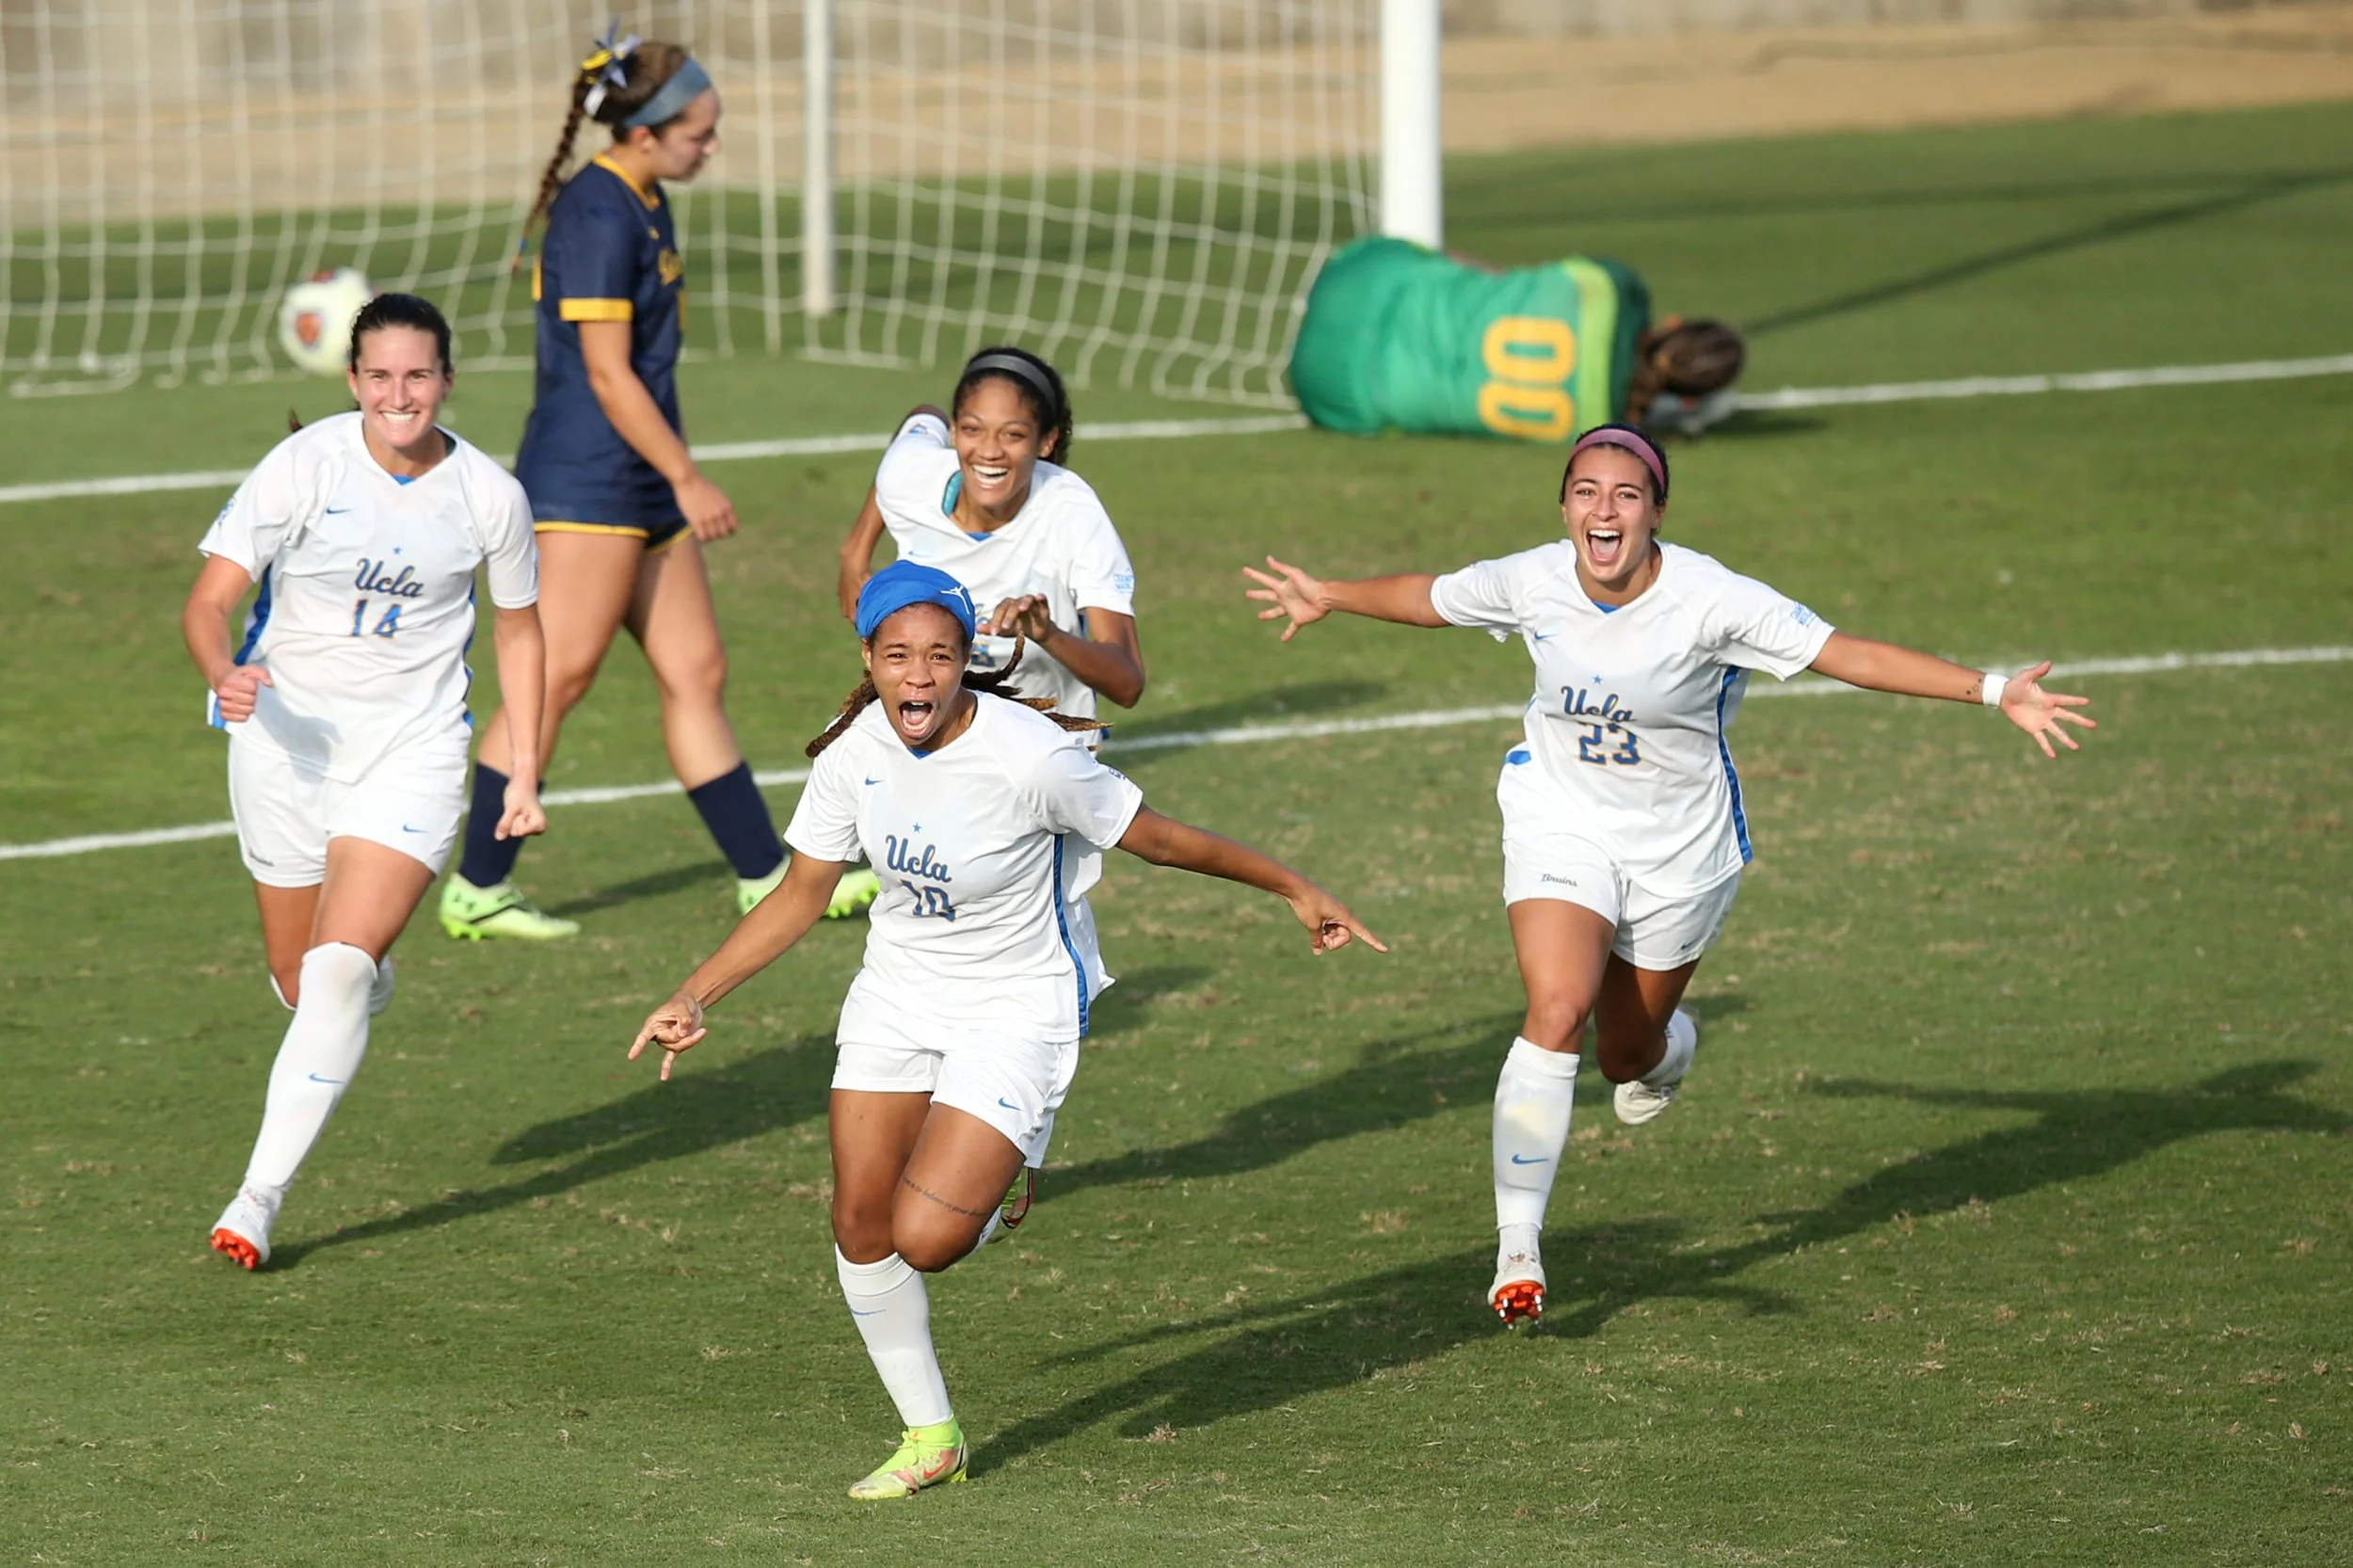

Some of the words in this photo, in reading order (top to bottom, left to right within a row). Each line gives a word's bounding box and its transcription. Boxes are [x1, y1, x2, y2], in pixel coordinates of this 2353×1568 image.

[1478, 316, 1576, 441] 00
[355, 558, 424, 598] Ucla
[1578, 722, 1641, 765] 23
[886, 835, 952, 883] Ucla
[1542, 873, 1577, 887] Bruins
